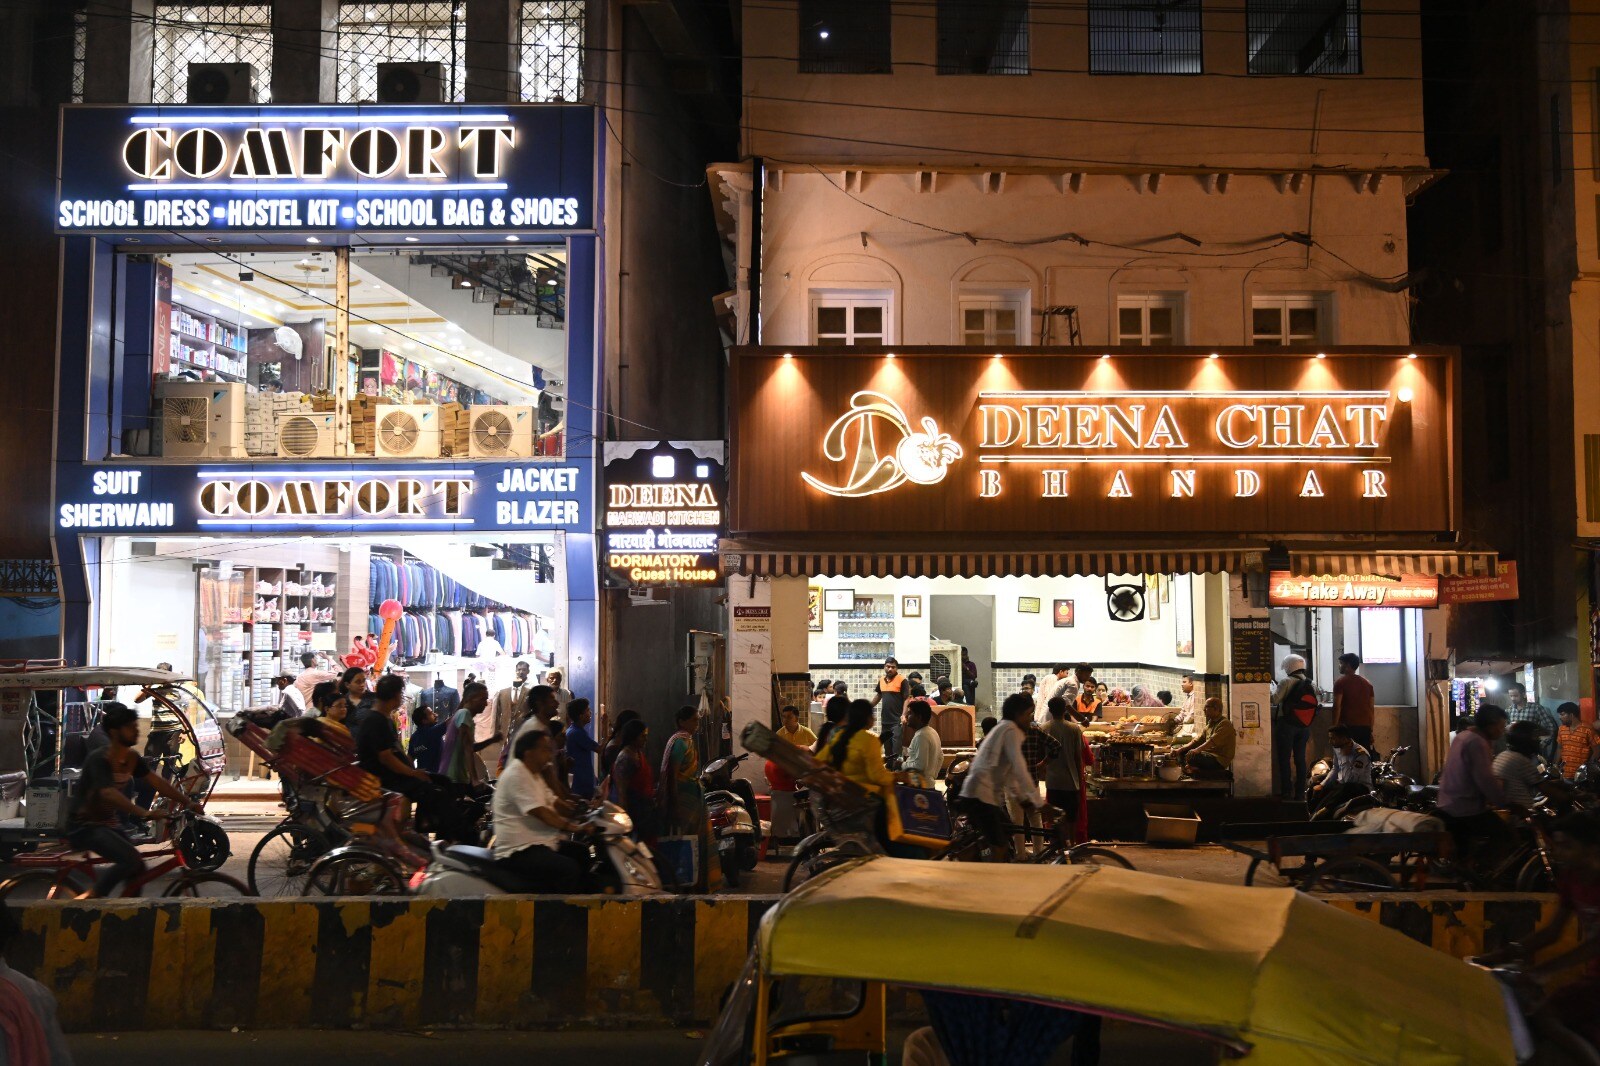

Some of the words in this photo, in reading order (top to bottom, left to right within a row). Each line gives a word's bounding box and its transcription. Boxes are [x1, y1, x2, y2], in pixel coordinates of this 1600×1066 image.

[122, 126, 515, 179] COMFORT
[59, 199, 138, 227] SCHOOL
[143, 199, 210, 227] DRESS
[227, 199, 302, 226] HOSTEL
[307, 199, 340, 226] KIT
[356, 198, 437, 226] SCHOOL
[443, 198, 484, 226] BAG
[489, 198, 505, 226] &
[510, 197, 579, 226] SHOES
[979, 404, 1189, 448] DEENA
[1215, 404, 1387, 448] CHAT
[92, 470, 142, 495] SUIT
[496, 467, 580, 492] JACKET
[979, 469, 1388, 498] BHANDAR
[199, 479, 473, 516] COMFORT
[609, 483, 718, 508] DEENA
[60, 503, 174, 527] SHERWANI
[496, 500, 579, 525] BLAZER
[607, 511, 666, 526] MARWADI
[667, 510, 720, 526] KITCHEN
[610, 554, 700, 568] DORMATORY
[630, 568, 671, 581] Guest
[673, 568, 717, 581] House
[1300, 582, 1339, 600] Take
[1342, 582, 1388, 605] Away
